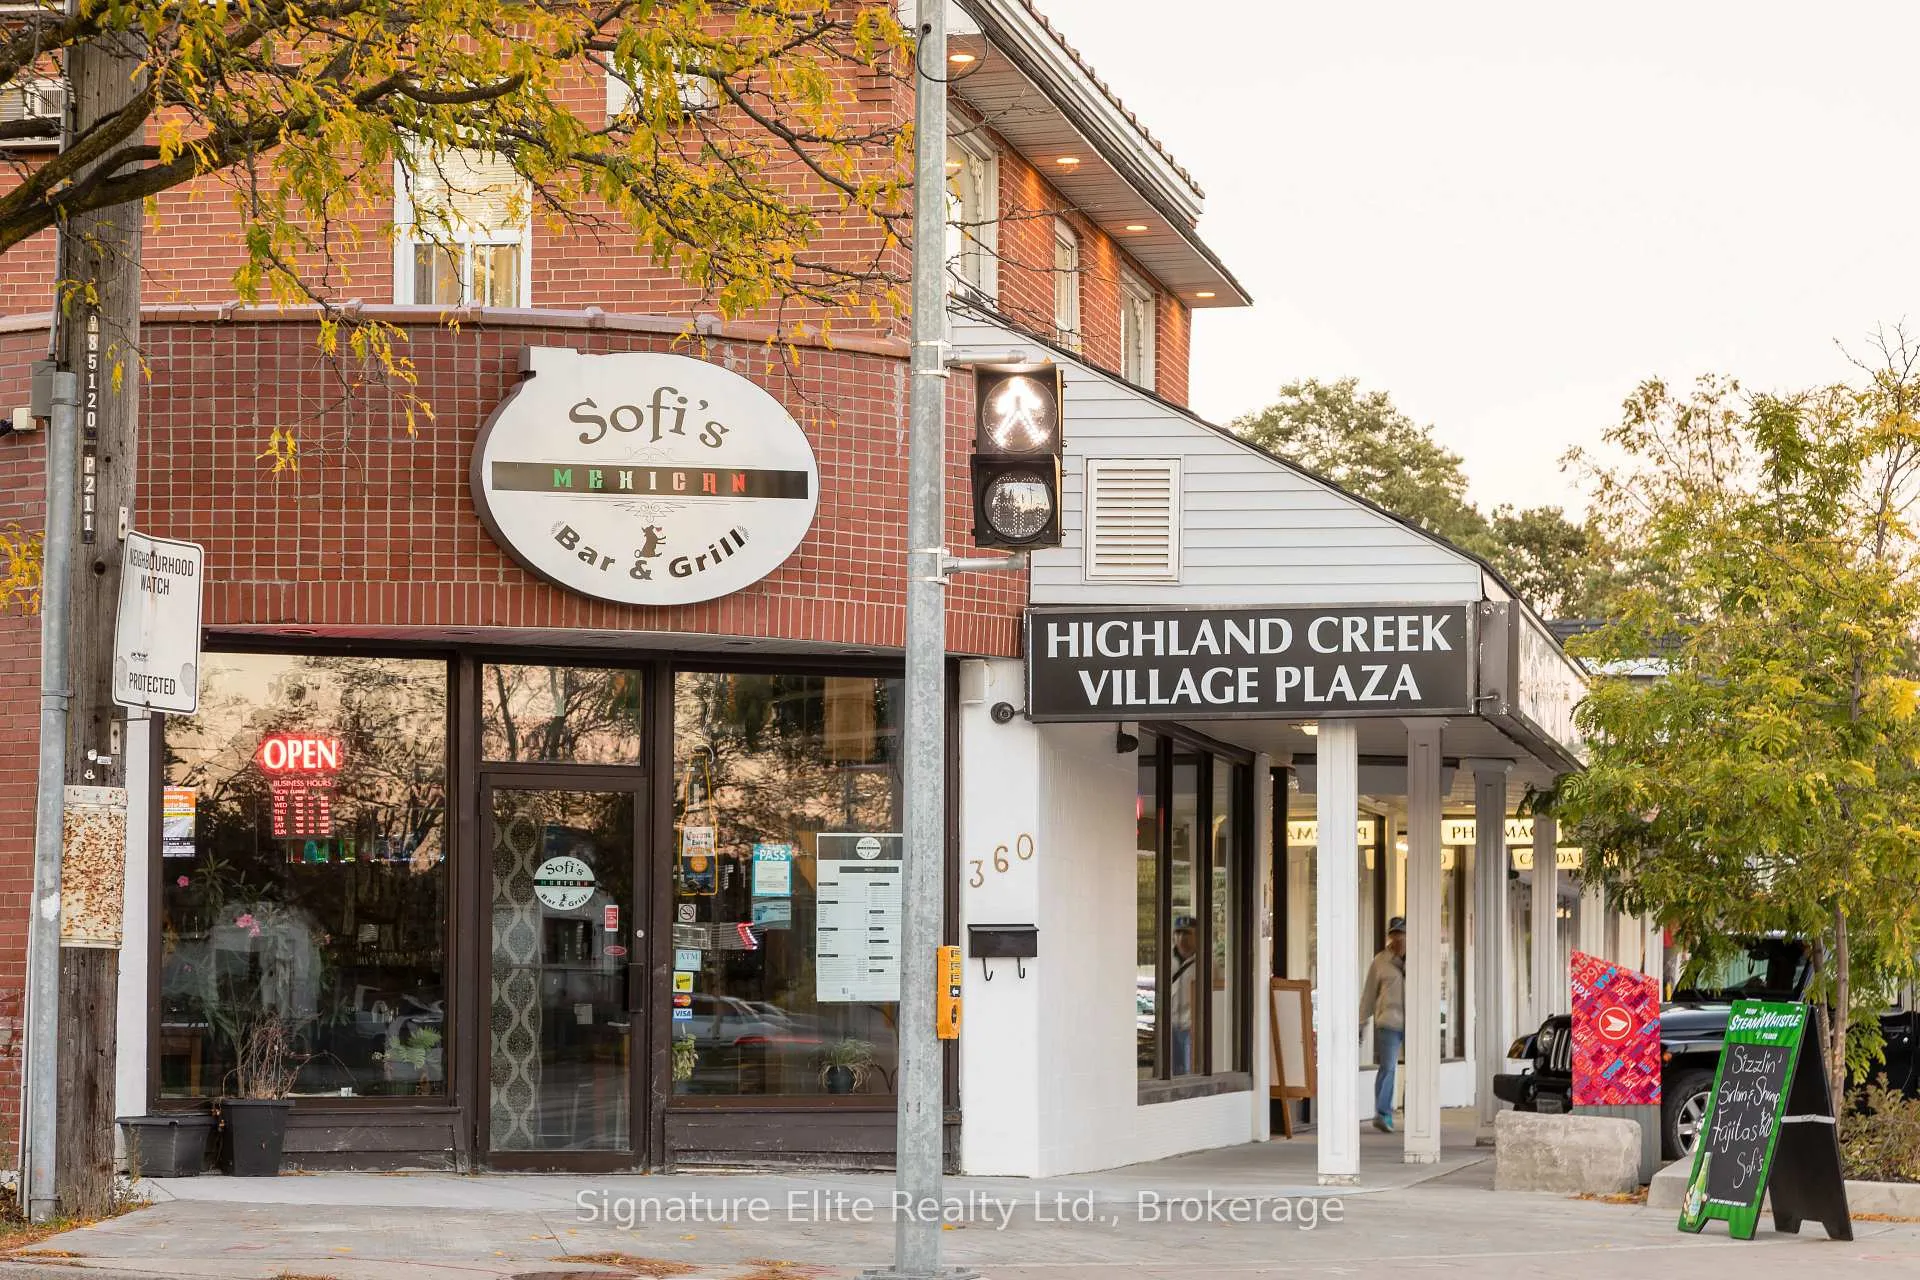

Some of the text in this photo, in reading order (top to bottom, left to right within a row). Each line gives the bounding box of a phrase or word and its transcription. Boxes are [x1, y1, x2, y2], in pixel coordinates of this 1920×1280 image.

[568, 386, 729, 448] Sofi's
[553, 468, 746, 495] MEXICAN
[129, 547, 194, 577] NEIGHBOURHOOD
[553, 524, 746, 580] Bar & Grill
[140, 574, 170, 595] WATCH
[1047, 614, 1452, 658] HIGHLAND CREEK
[129, 672, 176, 695] PROTECTED
[1078, 664, 1422, 705] VILLAGE PLAZA
[264, 739, 336, 768] OPEN
[545, 860, 584, 876] Sofi's
[760, 850, 786, 860] PASS
[969, 833, 1034, 888] 360
[680, 952, 698, 960] ATM
[1732, 1046, 1782, 1074] Sizzlin'
[1713, 1108, 1758, 1154] Fajitas
